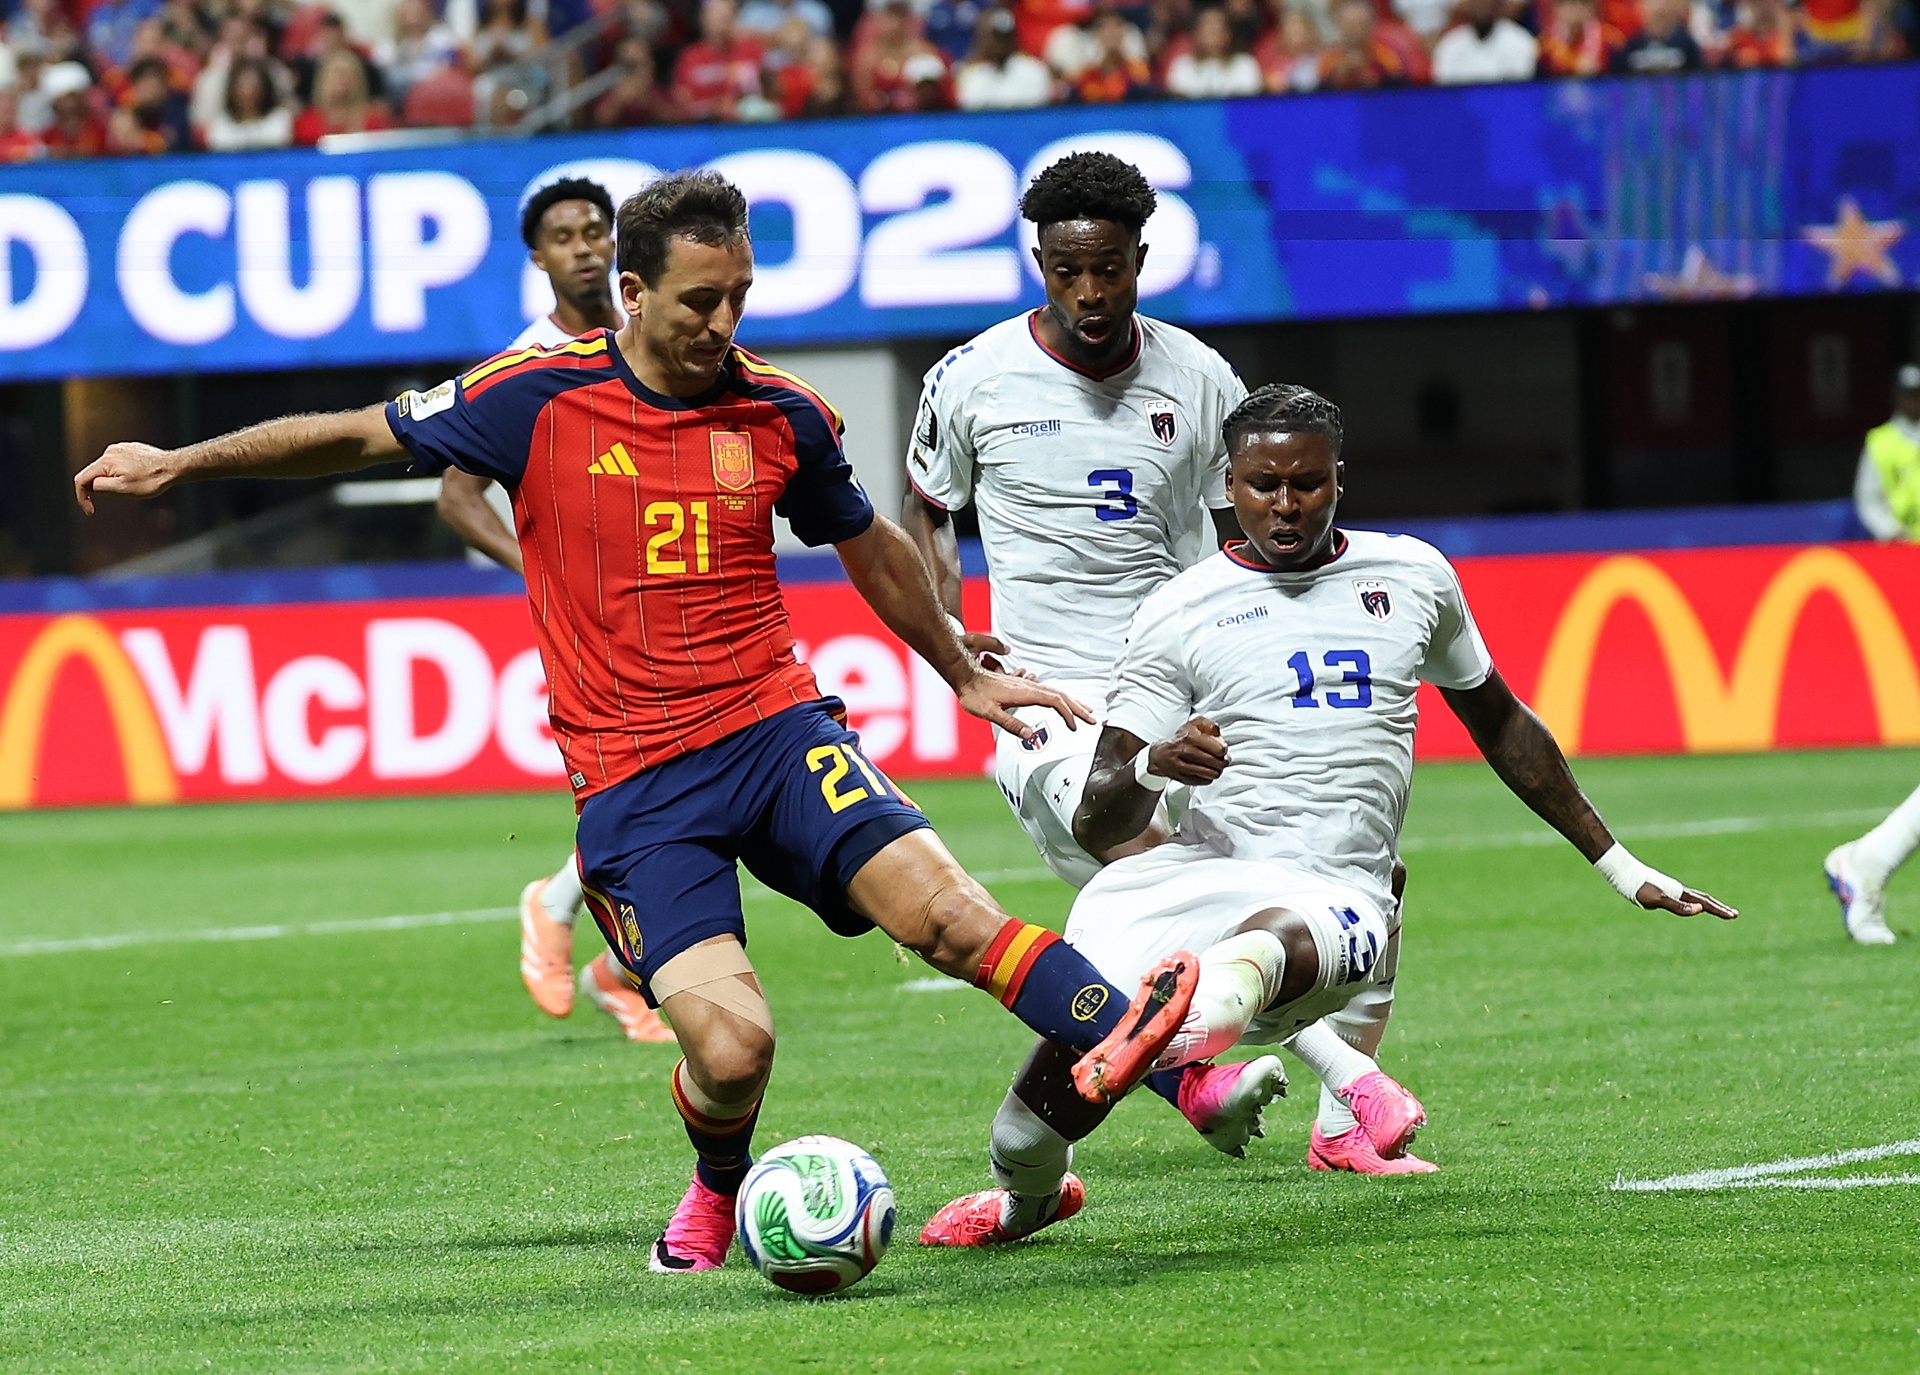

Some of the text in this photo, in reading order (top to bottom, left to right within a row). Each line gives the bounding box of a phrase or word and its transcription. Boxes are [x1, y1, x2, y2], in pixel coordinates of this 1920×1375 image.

[116, 169, 490, 345] CUP
[1011, 419, 1061, 436] capelli
[1087, 468, 1138, 522] 3
[644, 501, 710, 575] 21
[1216, 605, 1269, 628] capelli
[1287, 650, 1373, 709] 13
[805, 742, 889, 815] 21
